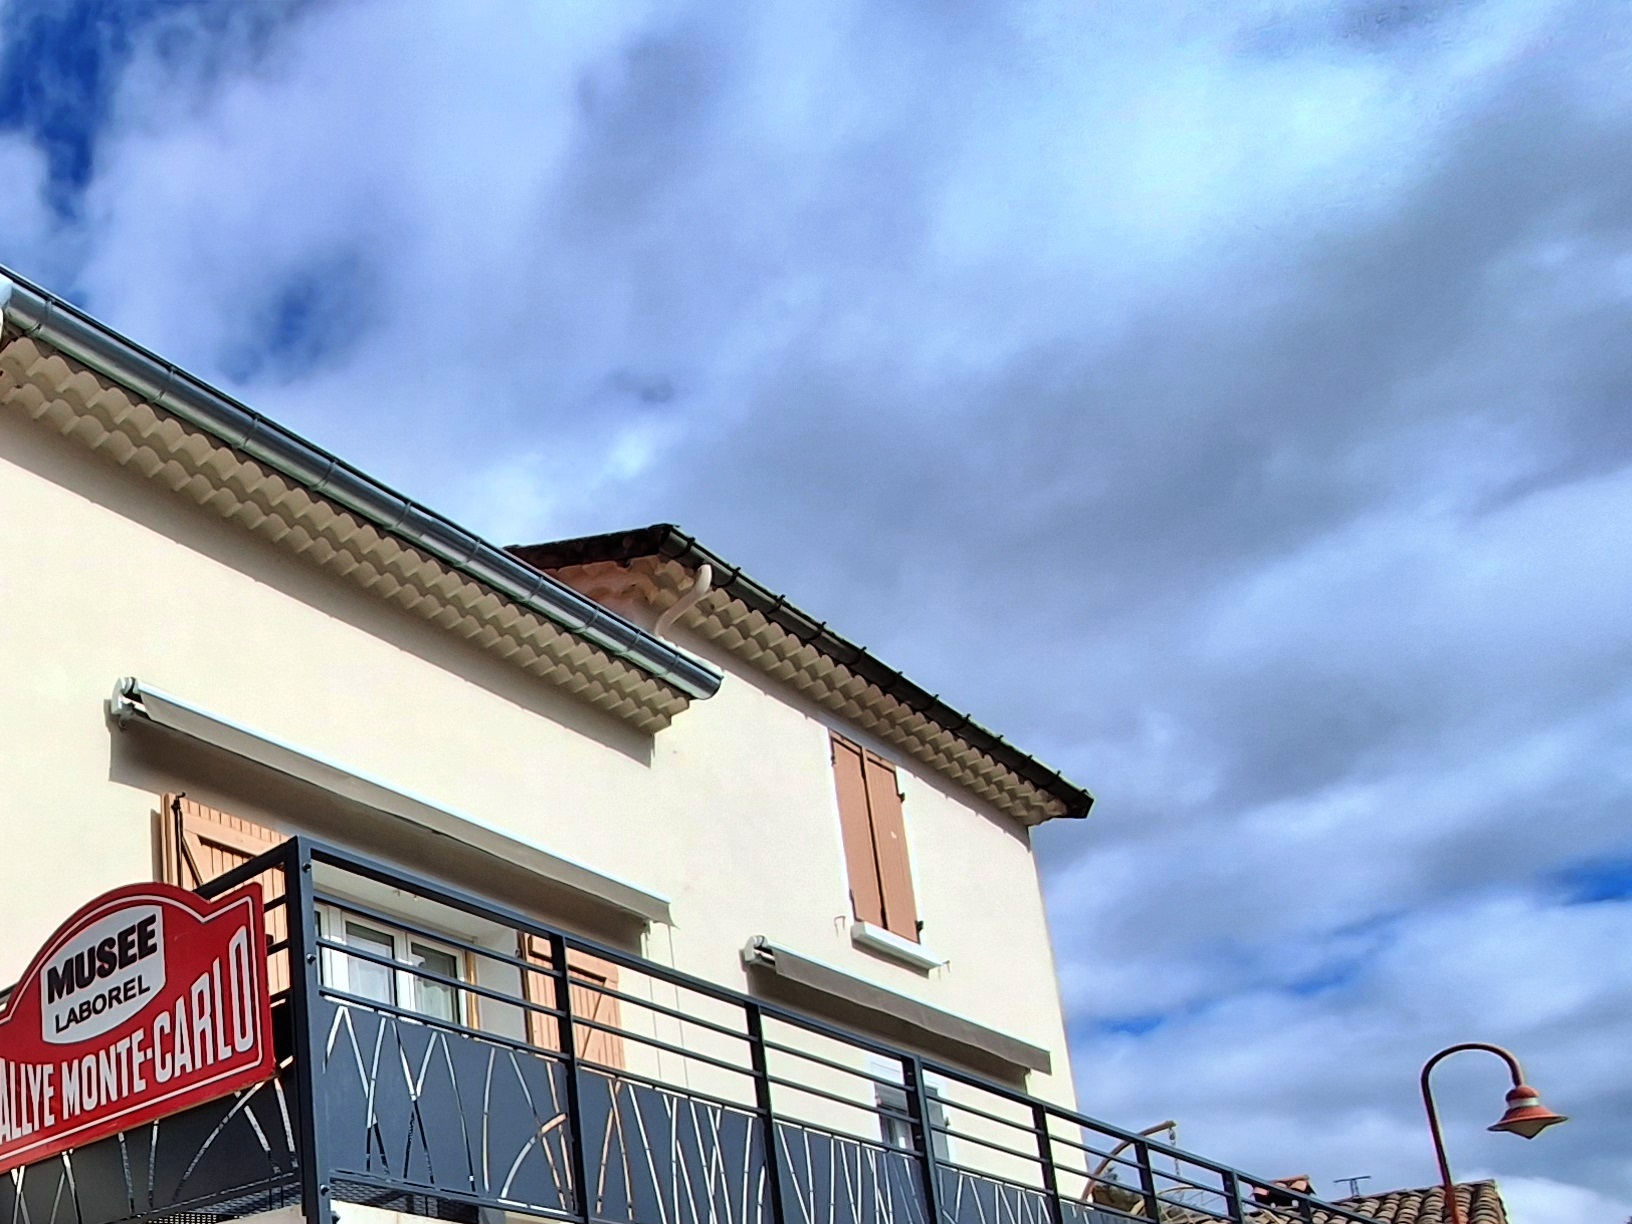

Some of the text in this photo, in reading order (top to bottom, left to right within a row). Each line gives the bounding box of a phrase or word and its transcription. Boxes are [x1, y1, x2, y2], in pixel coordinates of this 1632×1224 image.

[47, 914, 158, 1004] MUSEE
[54, 974, 151, 1034] LABOREL
[62, 924, 253, 1120] MONTE-CARLO
